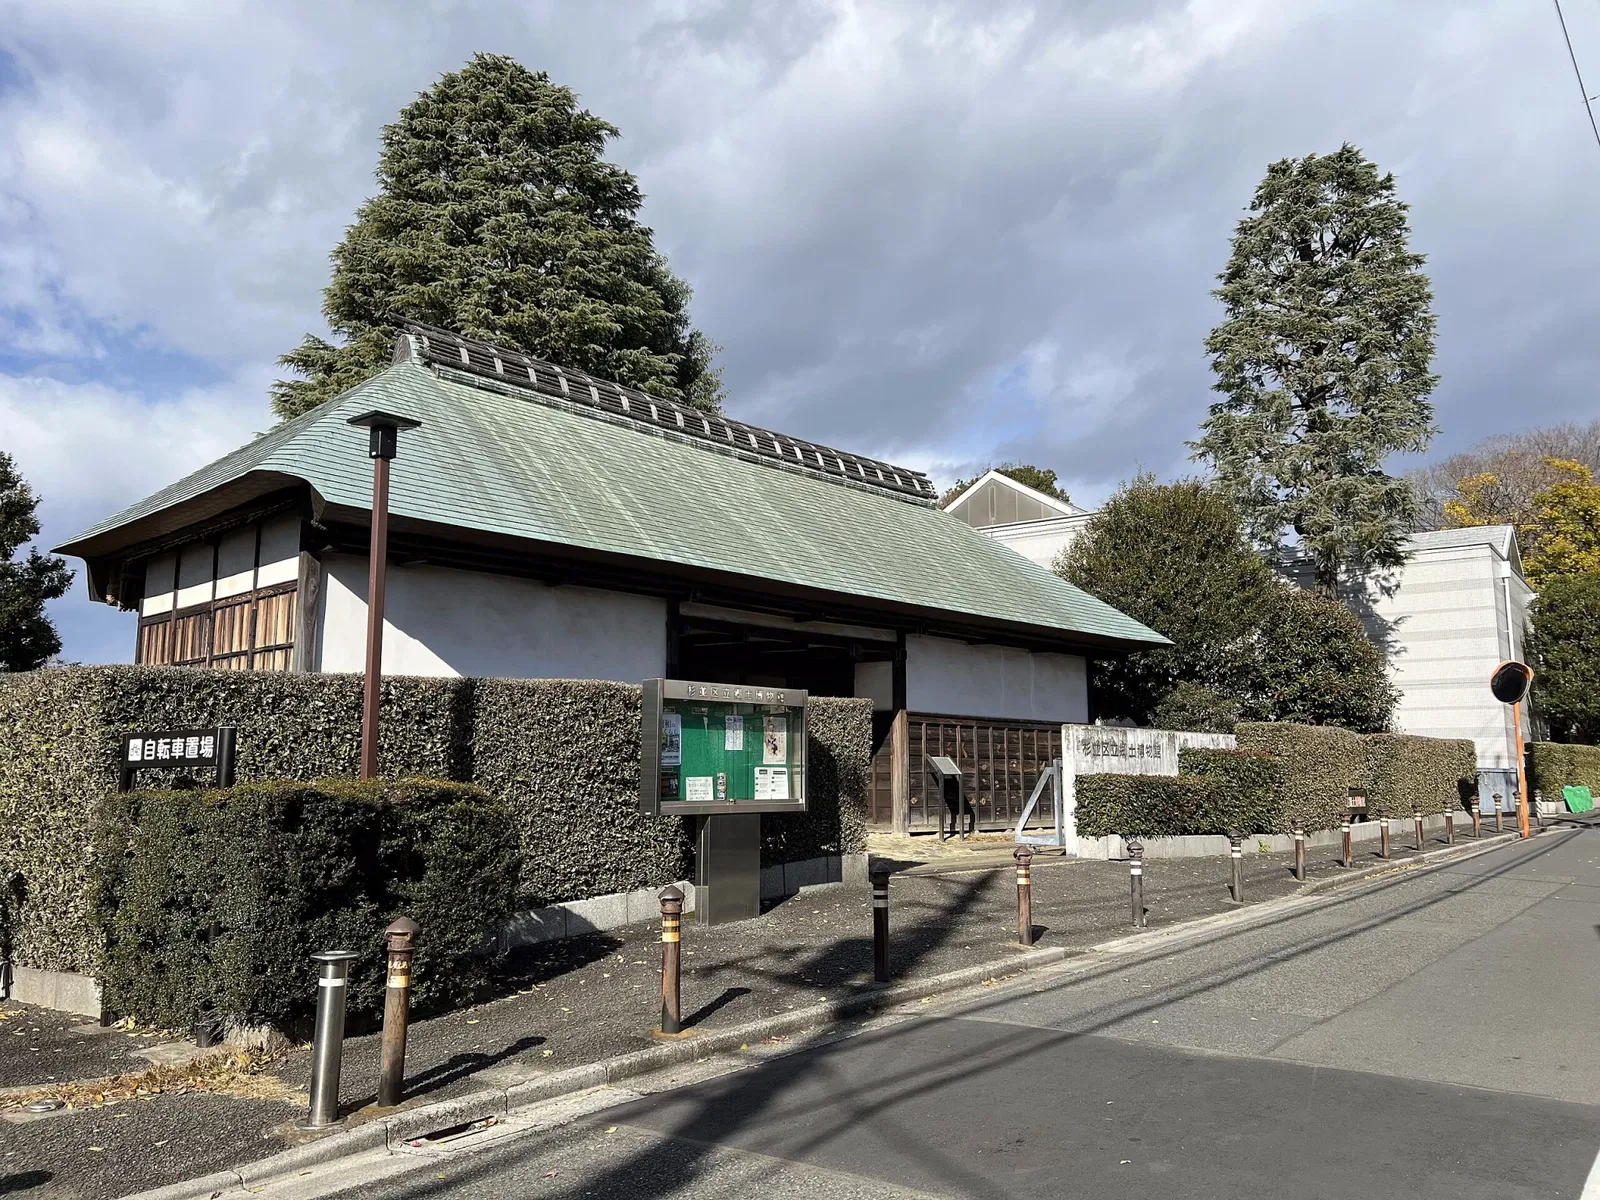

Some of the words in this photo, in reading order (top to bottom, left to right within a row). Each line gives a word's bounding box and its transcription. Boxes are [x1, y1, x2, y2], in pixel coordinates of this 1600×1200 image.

[687, 684, 785, 703] 杉並区立郷土博物館
[143, 735, 214, 760] 自転車置場
[1082, 738, 1161, 760] 杉並区立郷土博物館
